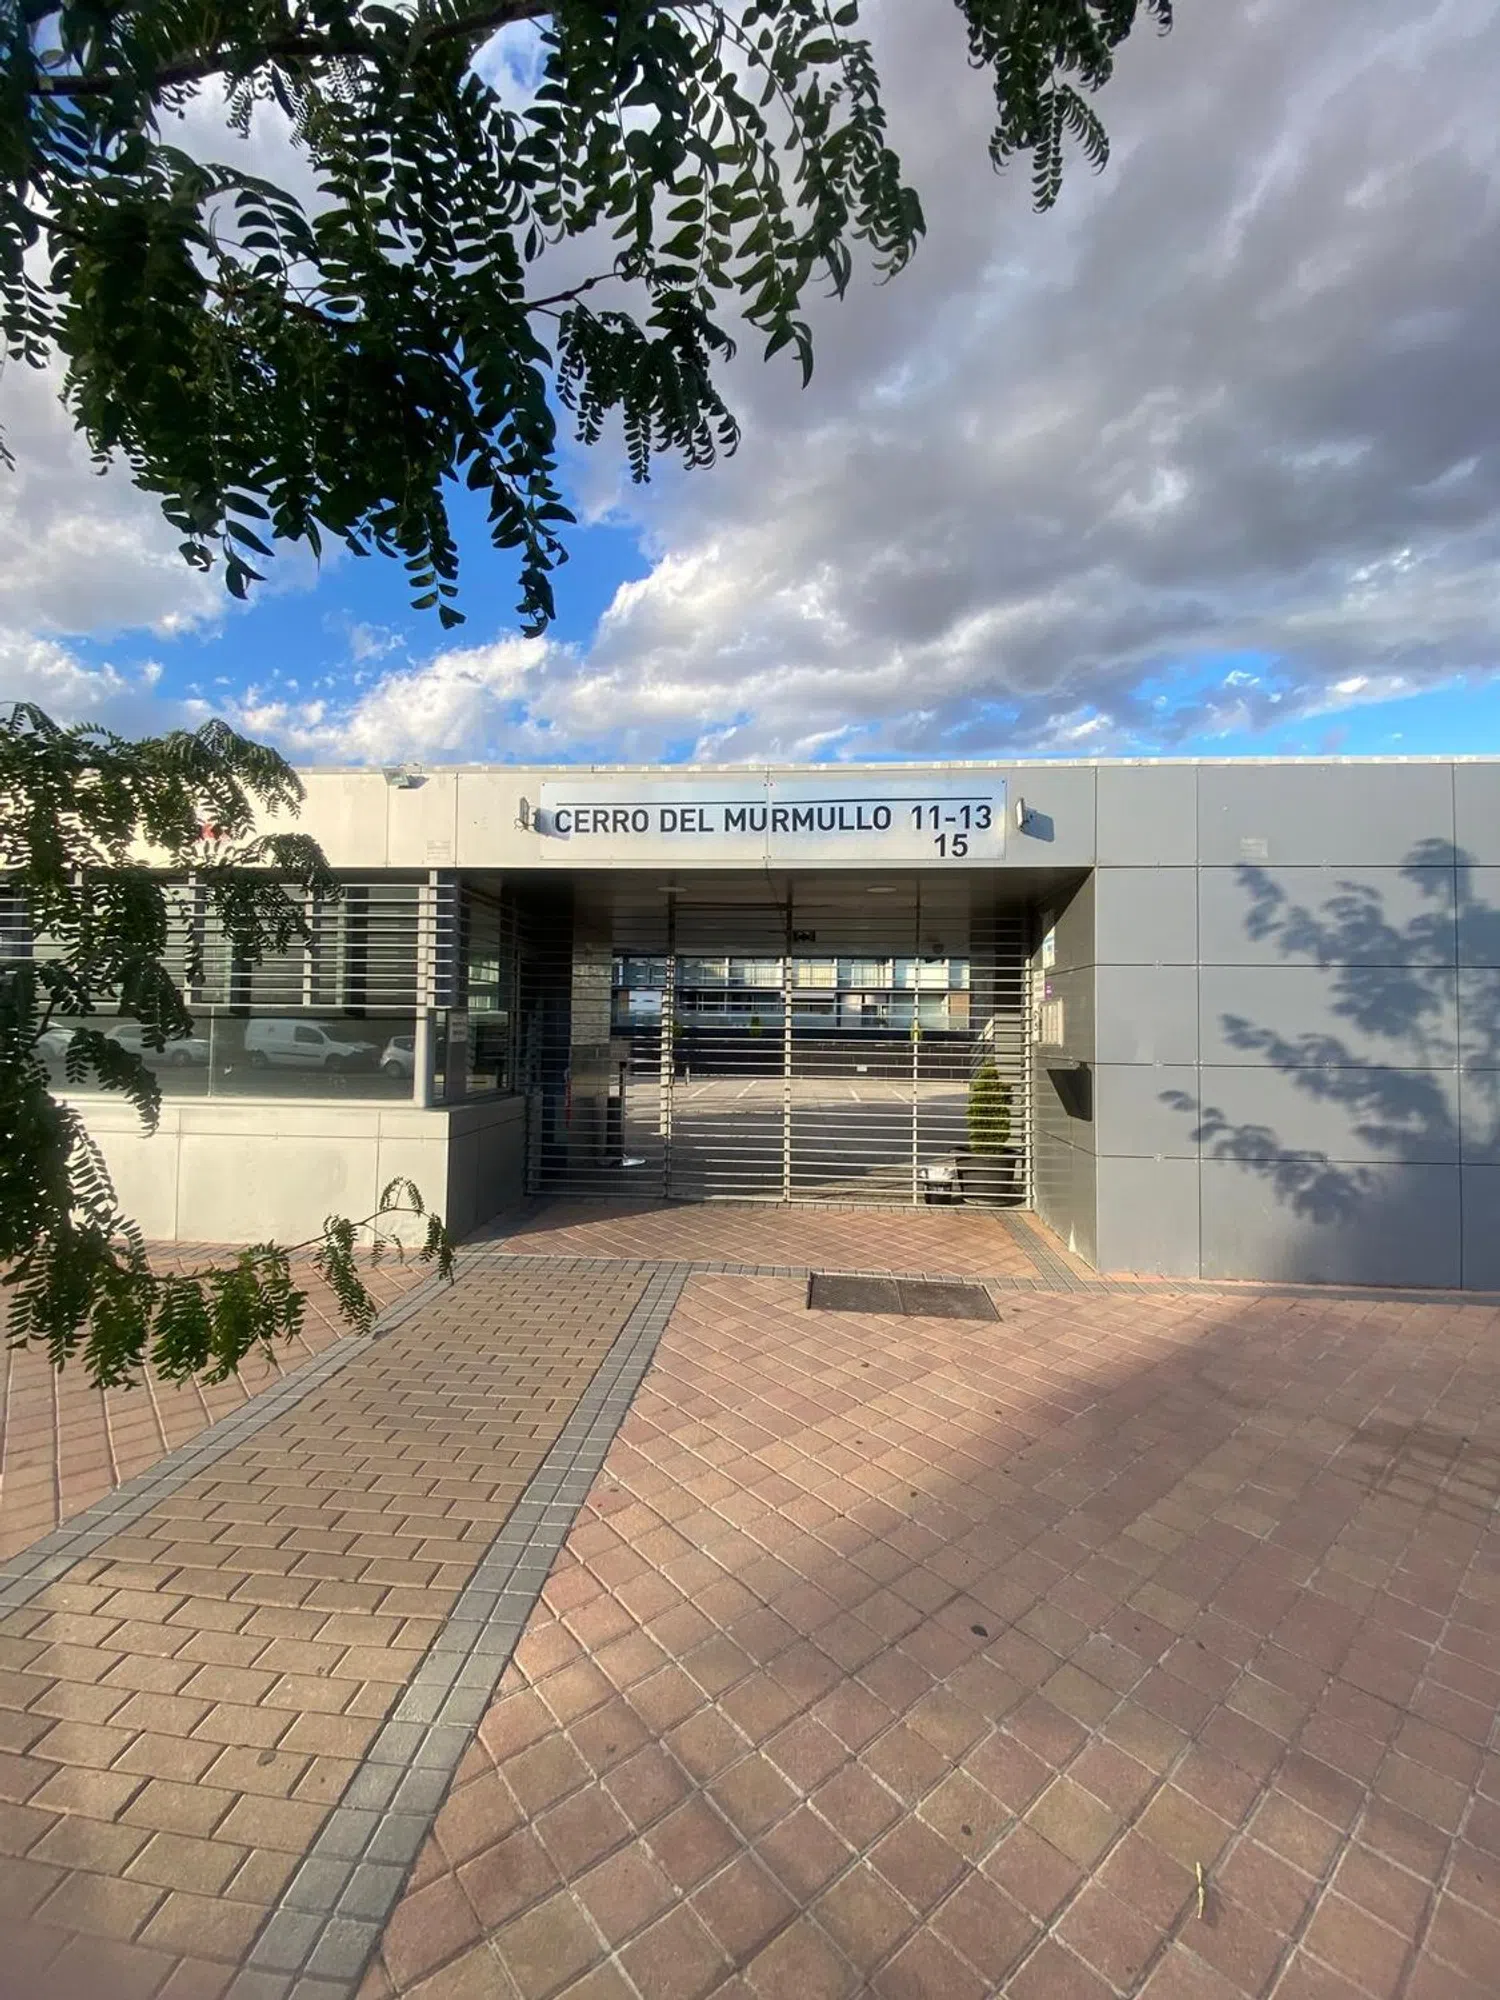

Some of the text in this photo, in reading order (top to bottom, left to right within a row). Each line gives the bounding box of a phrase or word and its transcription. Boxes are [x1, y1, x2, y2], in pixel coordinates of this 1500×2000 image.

[554, 805, 993, 833] CERRO DEL MURMULLO 11-13
[933, 833, 969, 857] 15
